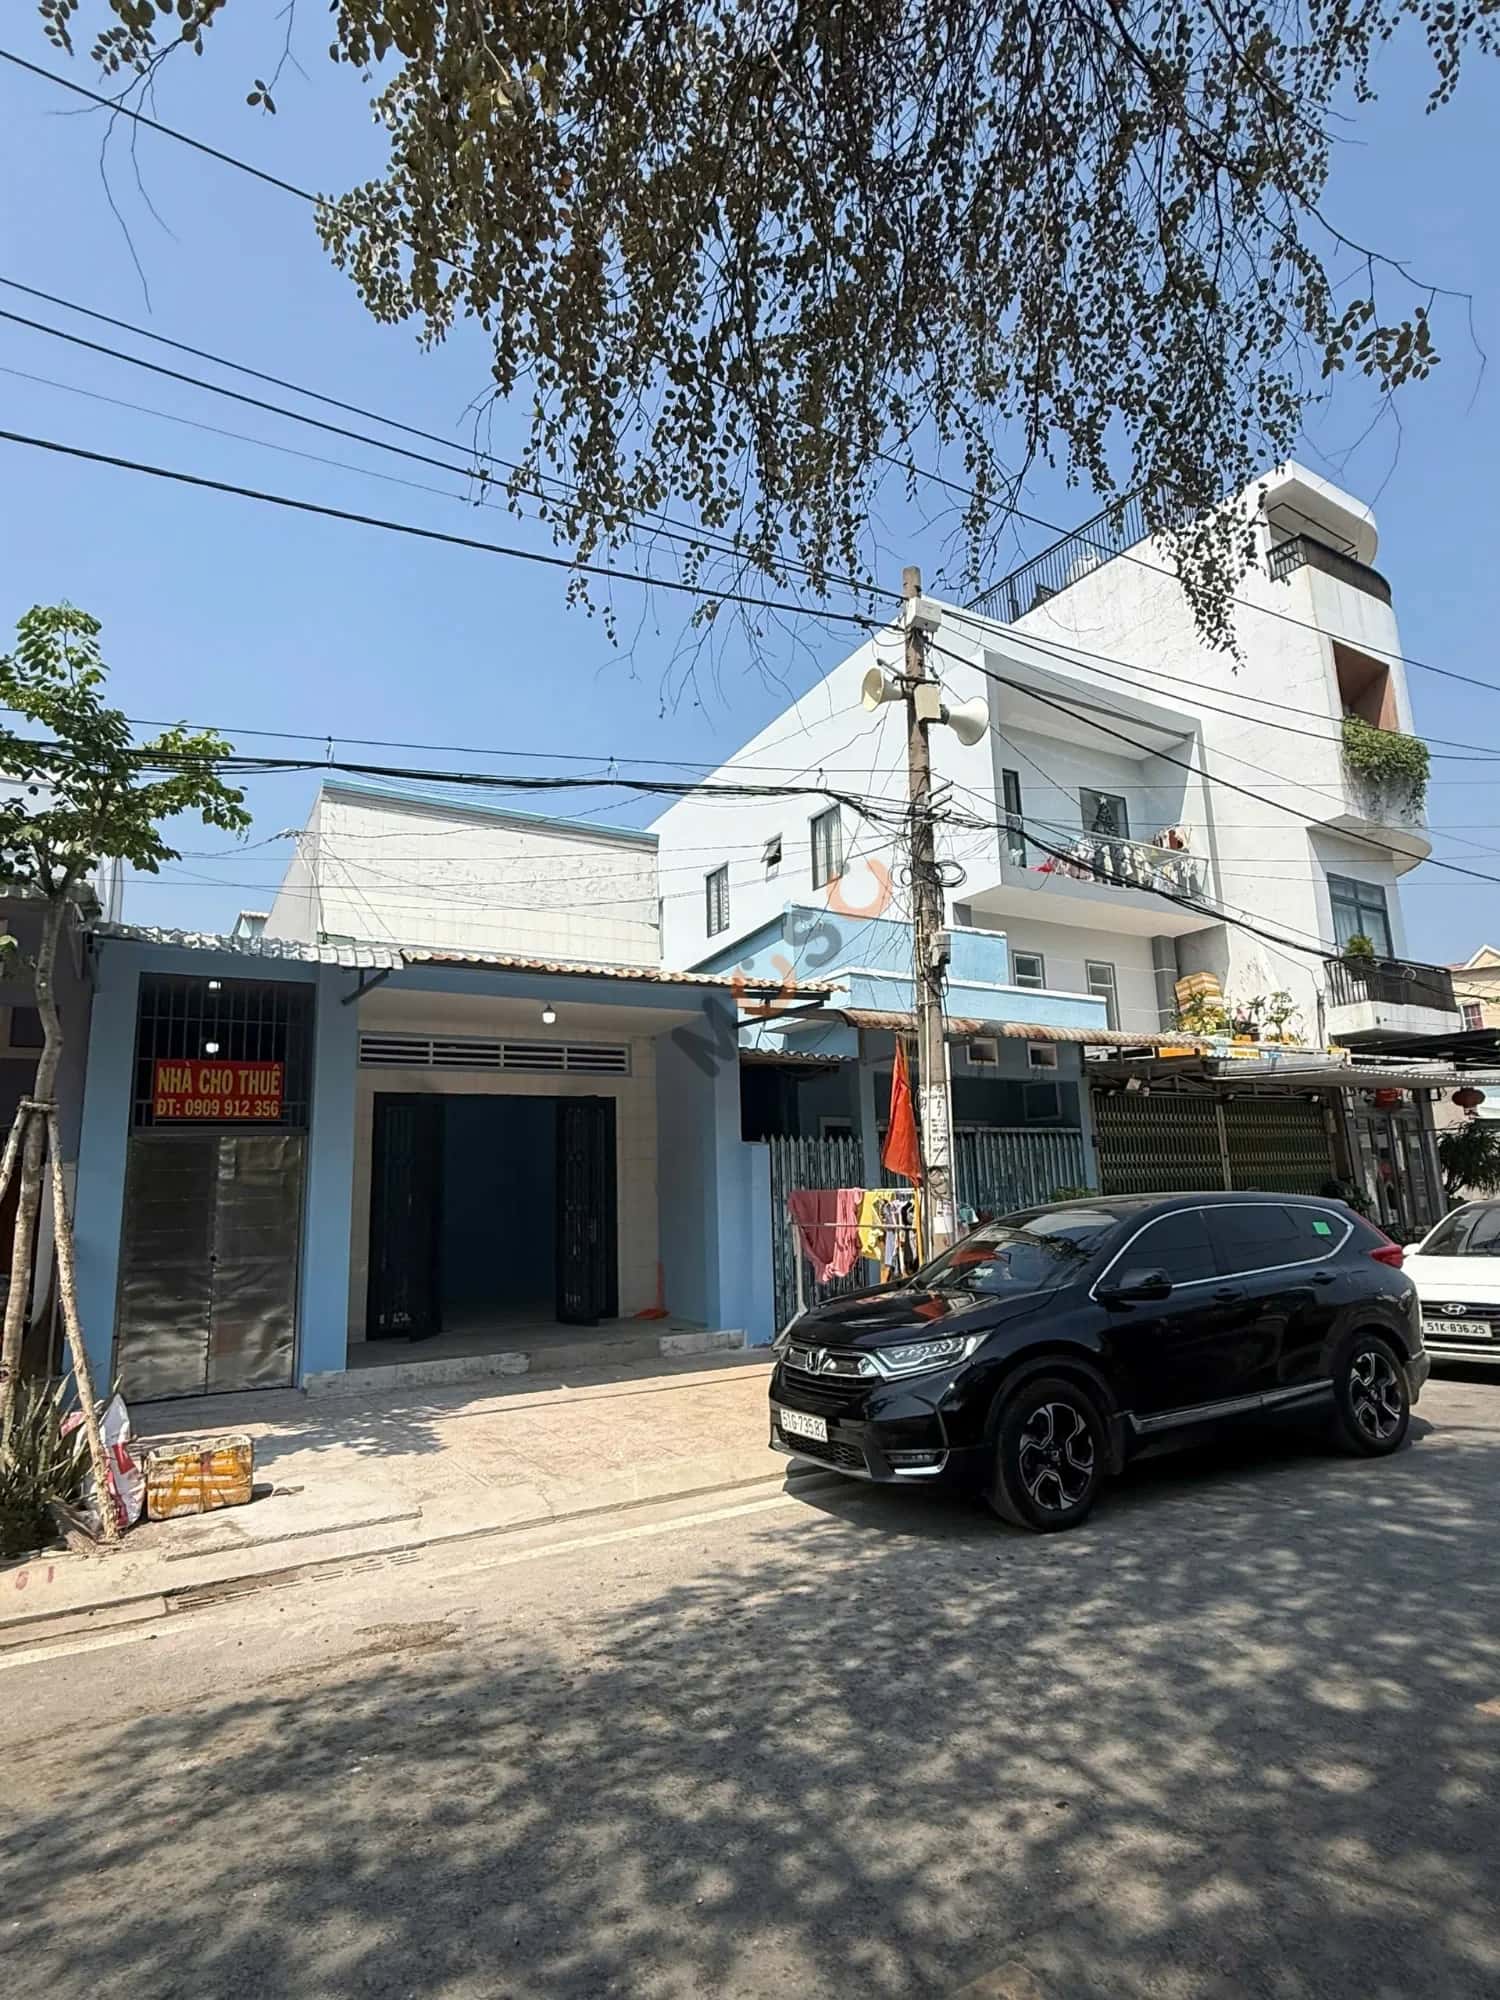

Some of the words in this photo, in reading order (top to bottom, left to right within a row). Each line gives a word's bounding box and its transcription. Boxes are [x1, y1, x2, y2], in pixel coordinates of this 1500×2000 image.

[158, 1061, 192, 1094] NHÀ
[199, 1068, 233, 1095] CHO
[238, 1064, 281, 1096] THUÊ
[156, 1099, 181, 1116] ĐT:
[185, 1099, 220, 1117] 0909
[223, 1100, 250, 1117] 912
[254, 1101, 279, 1117] 356
